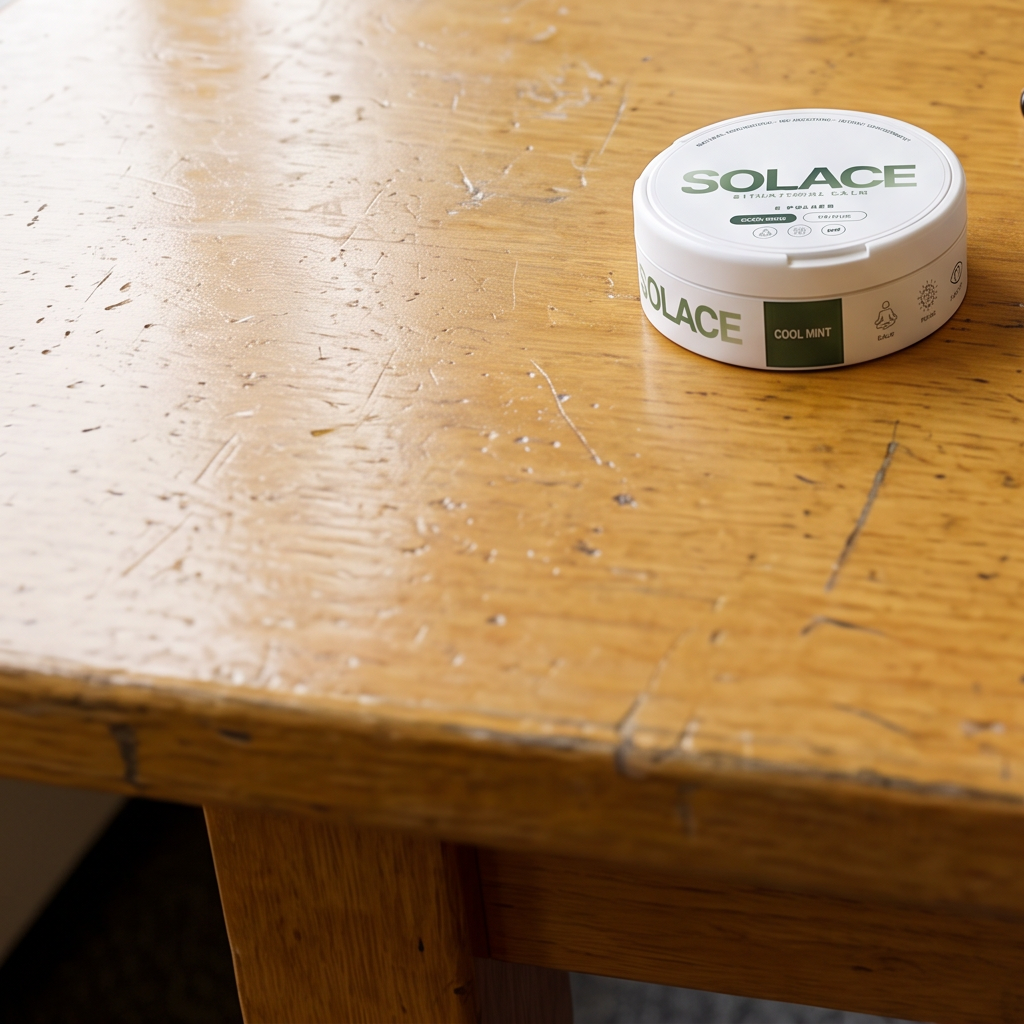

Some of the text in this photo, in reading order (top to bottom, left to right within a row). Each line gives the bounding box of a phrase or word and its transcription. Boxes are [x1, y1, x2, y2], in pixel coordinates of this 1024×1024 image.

[681, 164, 918, 195] SOLACE
[639, 264, 743, 345] SOLACE
[773, 326, 832, 341] COOL MINT
